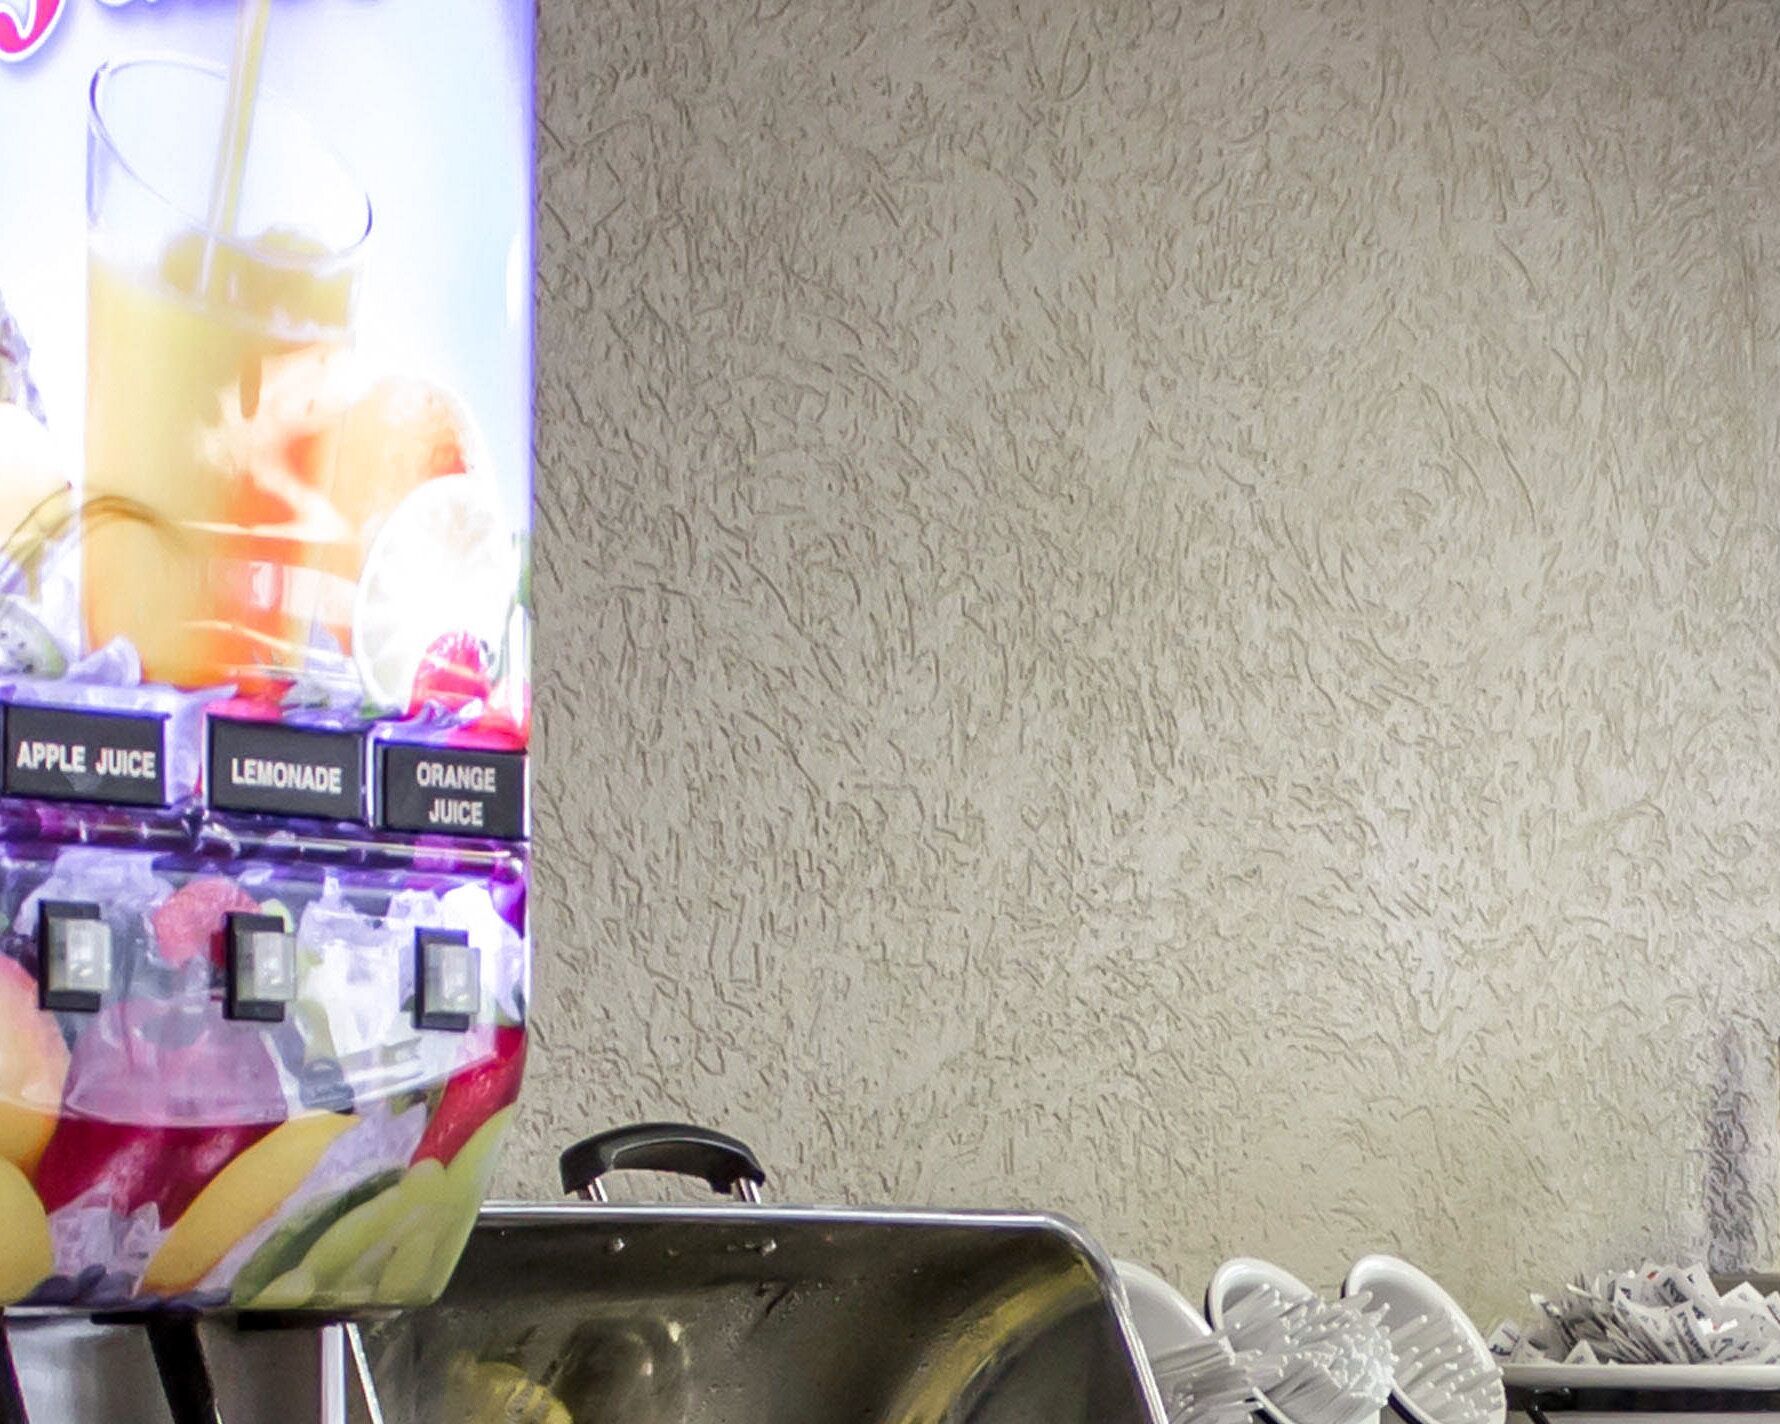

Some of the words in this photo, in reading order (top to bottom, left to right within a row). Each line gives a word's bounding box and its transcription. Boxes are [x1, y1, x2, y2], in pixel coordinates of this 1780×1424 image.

[16, 741, 86, 772] APPLE
[95, 748, 156, 779] JUICE
[231, 757, 342, 795] LEMONADE
[416, 761, 496, 793] ORANGE
[428, 799, 483, 827] JUICE
